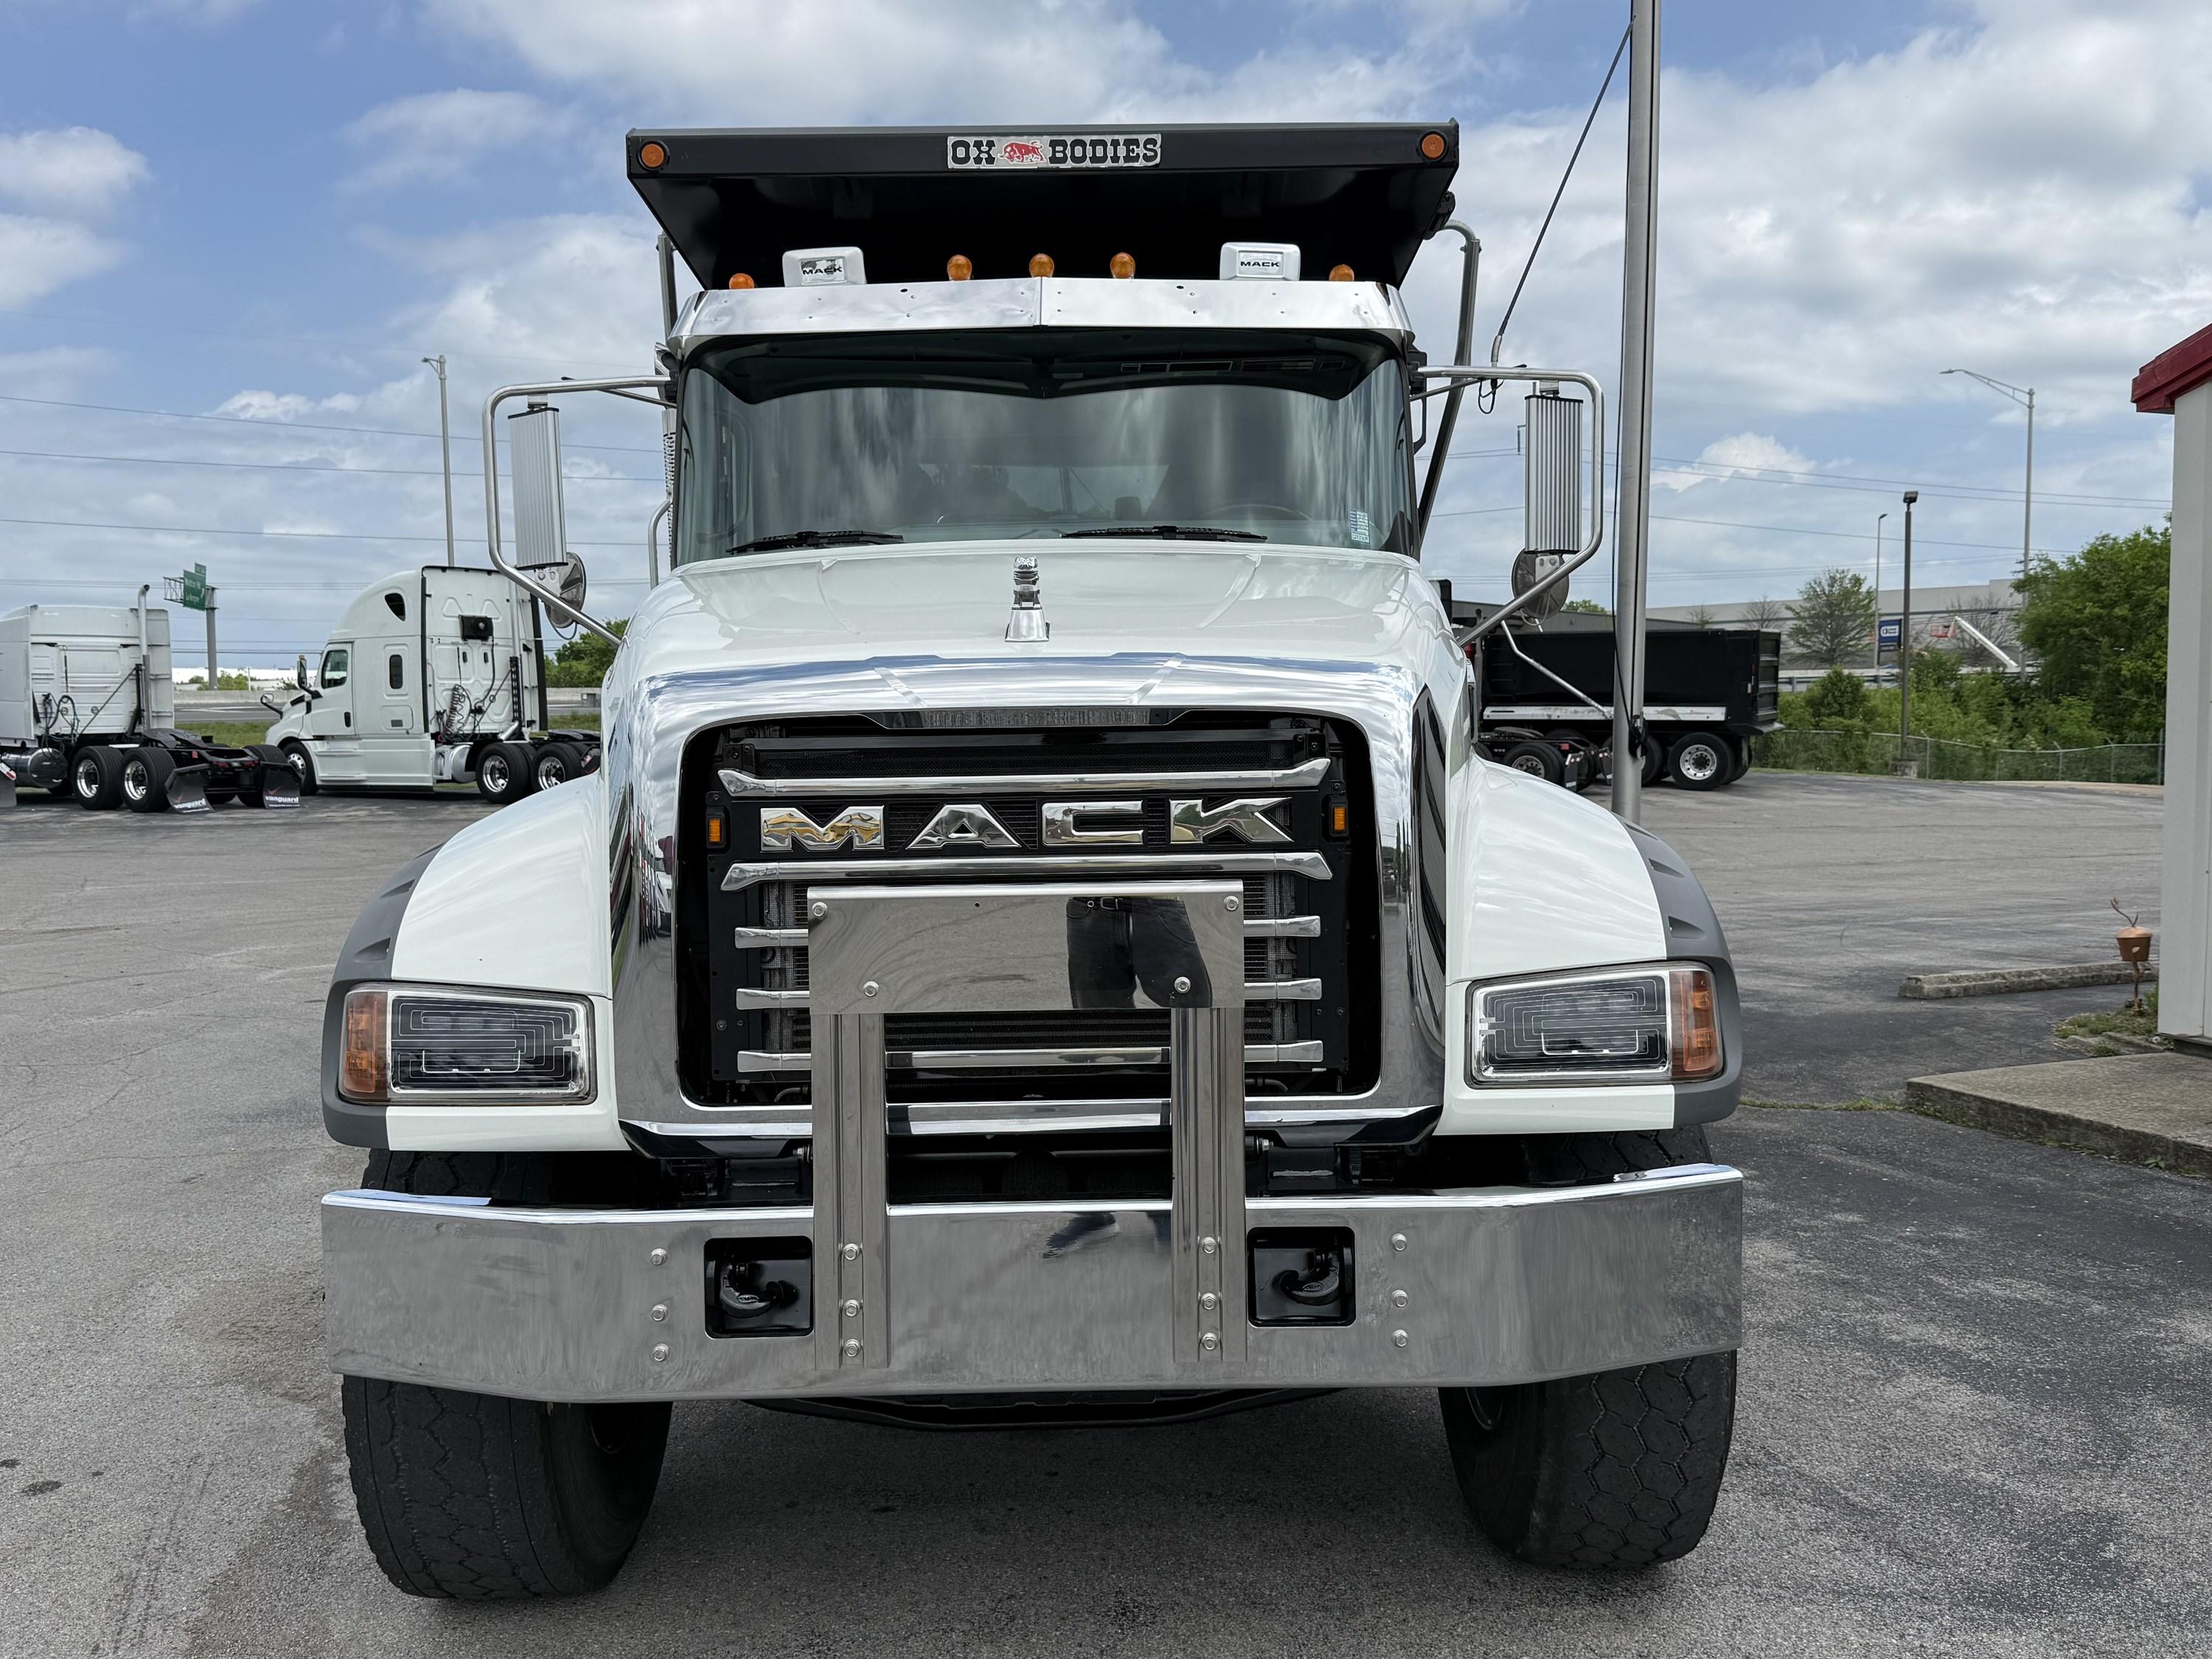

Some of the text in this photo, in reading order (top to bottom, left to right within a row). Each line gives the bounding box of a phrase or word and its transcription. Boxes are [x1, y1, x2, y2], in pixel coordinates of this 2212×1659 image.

[950, 137, 1158, 166] OX BODIES
[802, 265, 843, 275] MACK
[759, 796, 1294, 852] MACK
